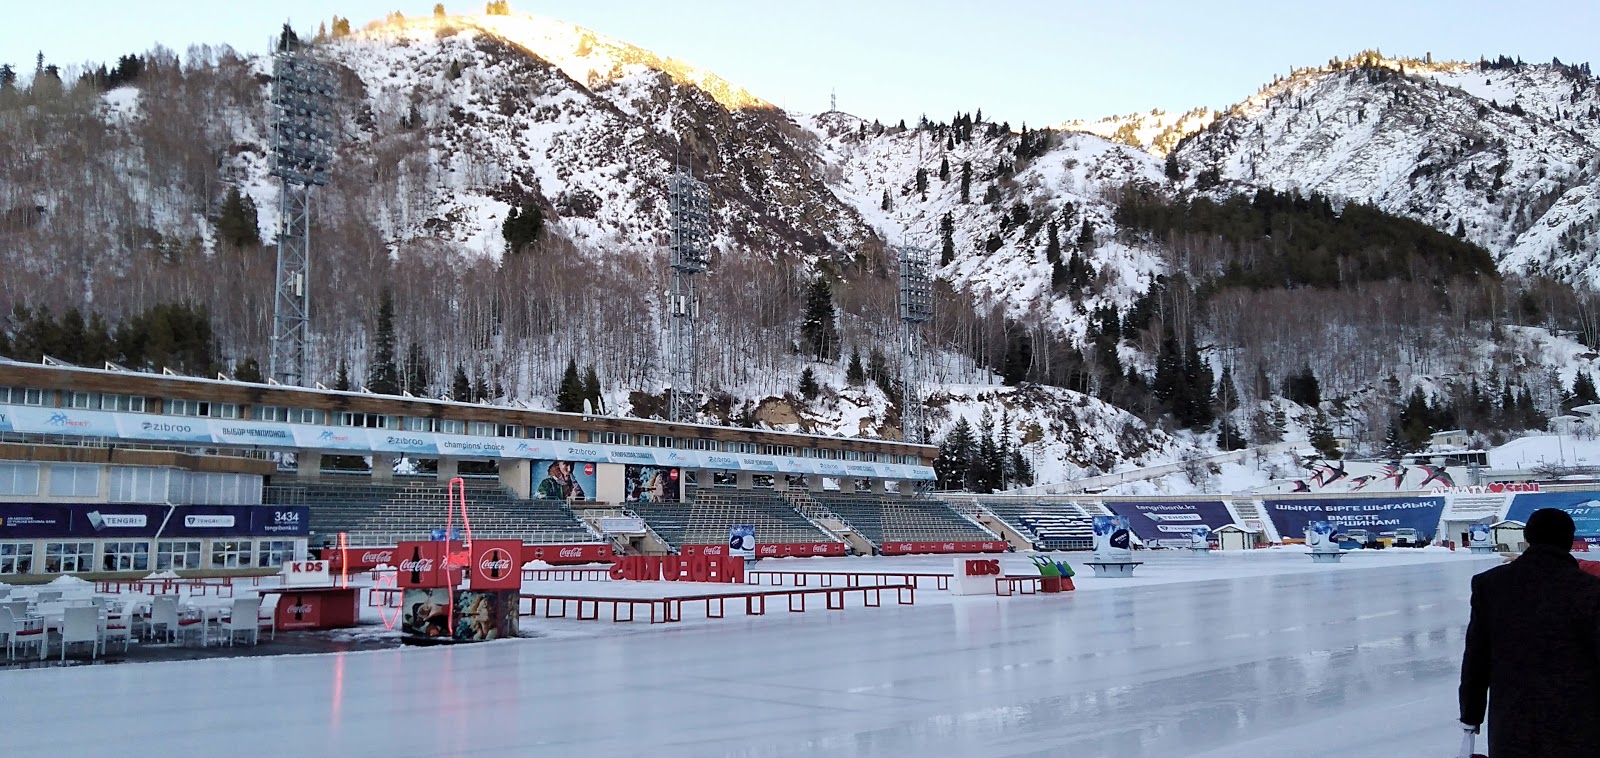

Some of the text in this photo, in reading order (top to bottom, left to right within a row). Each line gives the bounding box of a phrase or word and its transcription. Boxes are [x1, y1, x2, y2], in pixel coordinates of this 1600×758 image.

[153, 423, 191, 433] zibroo
[246, 430, 286, 438] ЧЕМПИОНОВ
[395, 438, 423, 446] zibroo
[1430, 485, 1488, 496] ALMATY
[1135, 504, 1197, 512] tengribank.kz
[274, 511, 299, 522] 3434
[559, 547, 582, 558] Coca-Cola
[703, 546, 721, 555] Coca-Cola
[760, 545, 777, 554] Coca-Cola
[361, 551, 393, 563] Coca-Cola
[399, 558, 433, 572] Coca-Cola
[481, 559, 510, 569] Coca-Cola
[965, 559, 1001, 576] KIDS
